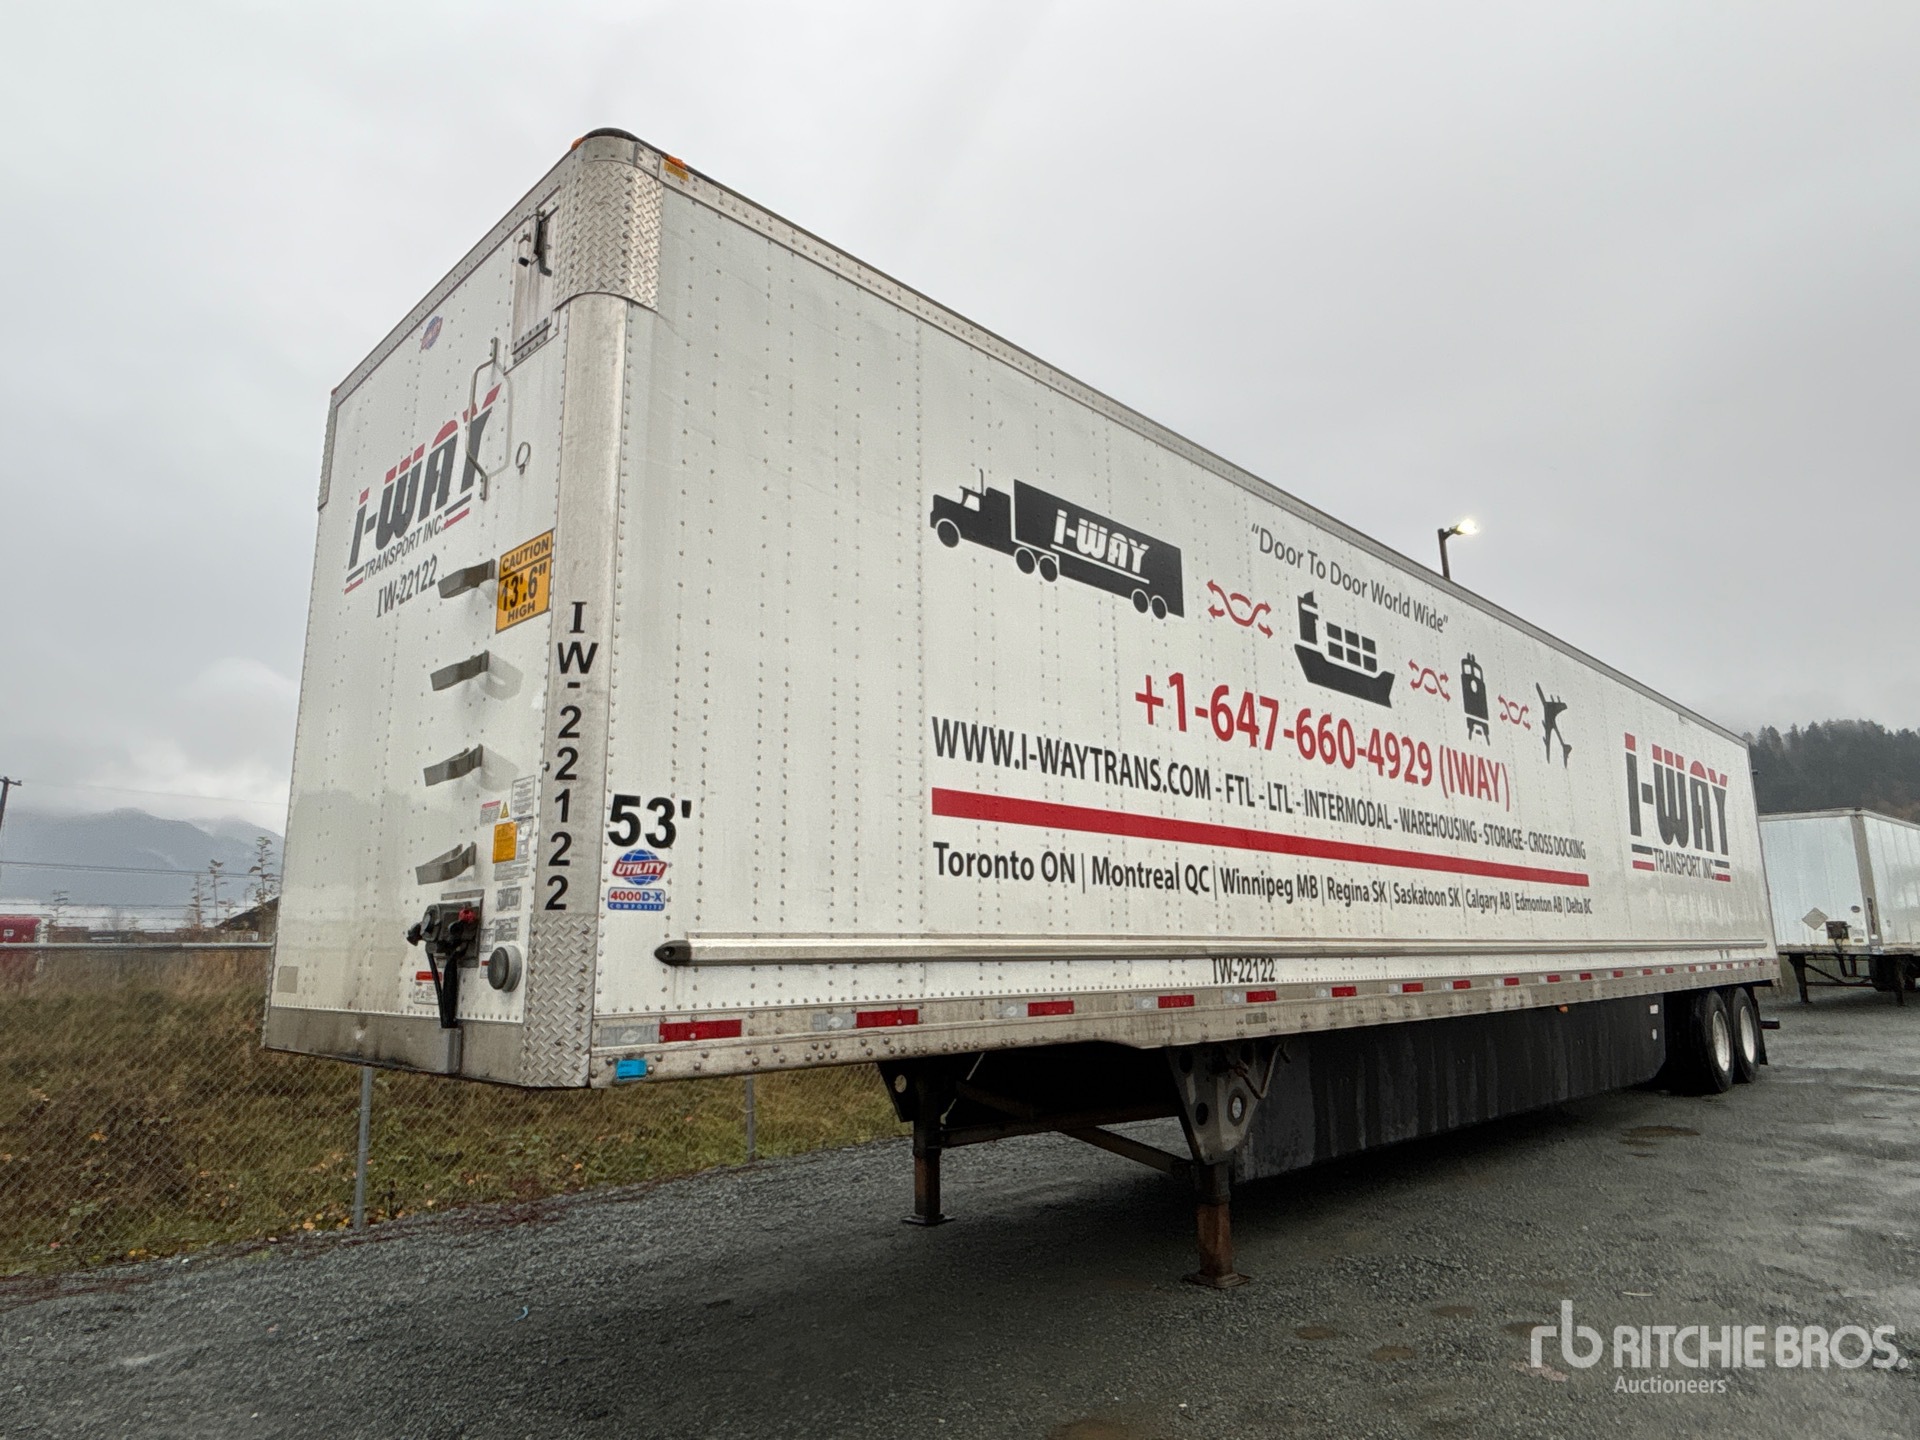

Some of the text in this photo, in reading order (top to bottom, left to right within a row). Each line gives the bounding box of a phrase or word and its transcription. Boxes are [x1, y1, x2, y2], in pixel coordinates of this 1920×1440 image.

[364, 514, 446, 580] TRANSPORT INC.
[502, 537, 550, 572] CAUTION
[376, 553, 438, 618] IW-22122
[507, 600, 536, 622] HIGH
[1307, 549, 1326, 579] To
[1330, 561, 1368, 598] Door
[1370, 580, 1410, 618] World
[1135, 672, 1510, 812] +1-647-660-4929 (IWAY)
[932, 716, 1212, 801] WWW.I-WAYTRANS.COM
[1225, 773, 1255, 807] FTL
[1267, 781, 1293, 814] LTL
[1304, 788, 1392, 830] INTERMODAL
[1399, 806, 1478, 843] WAREHOUSING
[1484, 823, 1524, 851] STORAGE
[1528, 831, 1552, 855] CROSS
[1553, 836, 1586, 860] DOCKING
[607, 793, 692, 849] 53'
[615, 862, 665, 875] UTILITY
[933, 841, 1035, 881] Toronto
[1041, 851, 1075, 883] ON
[1092, 855, 1180, 890] Montreal
[1185, 865, 1210, 893] QC
[1220, 868, 1293, 904] Winnipeg
[1297, 874, 1318, 899] MB
[1327, 877, 1369, 907] Regina
[1372, 880, 1387, 902] SK
[1393, 882, 1446, 907] Saskatoon
[1448, 887, 1461, 907] SK
[1466, 889, 1498, 914] Calgary
[1500, 891, 1511, 910] AB
[1515, 893, 1552, 913] Edmonton
[1553, 896, 1562, 913] AB
[1566, 898, 1583, 914] Delta
[1583, 899, 1592, 915] BC
[1653, 847, 1716, 881] TRANSPORT INC.
[610, 890, 662, 902] 4000D-X
[1211, 956, 1276, 984] IW-22122
